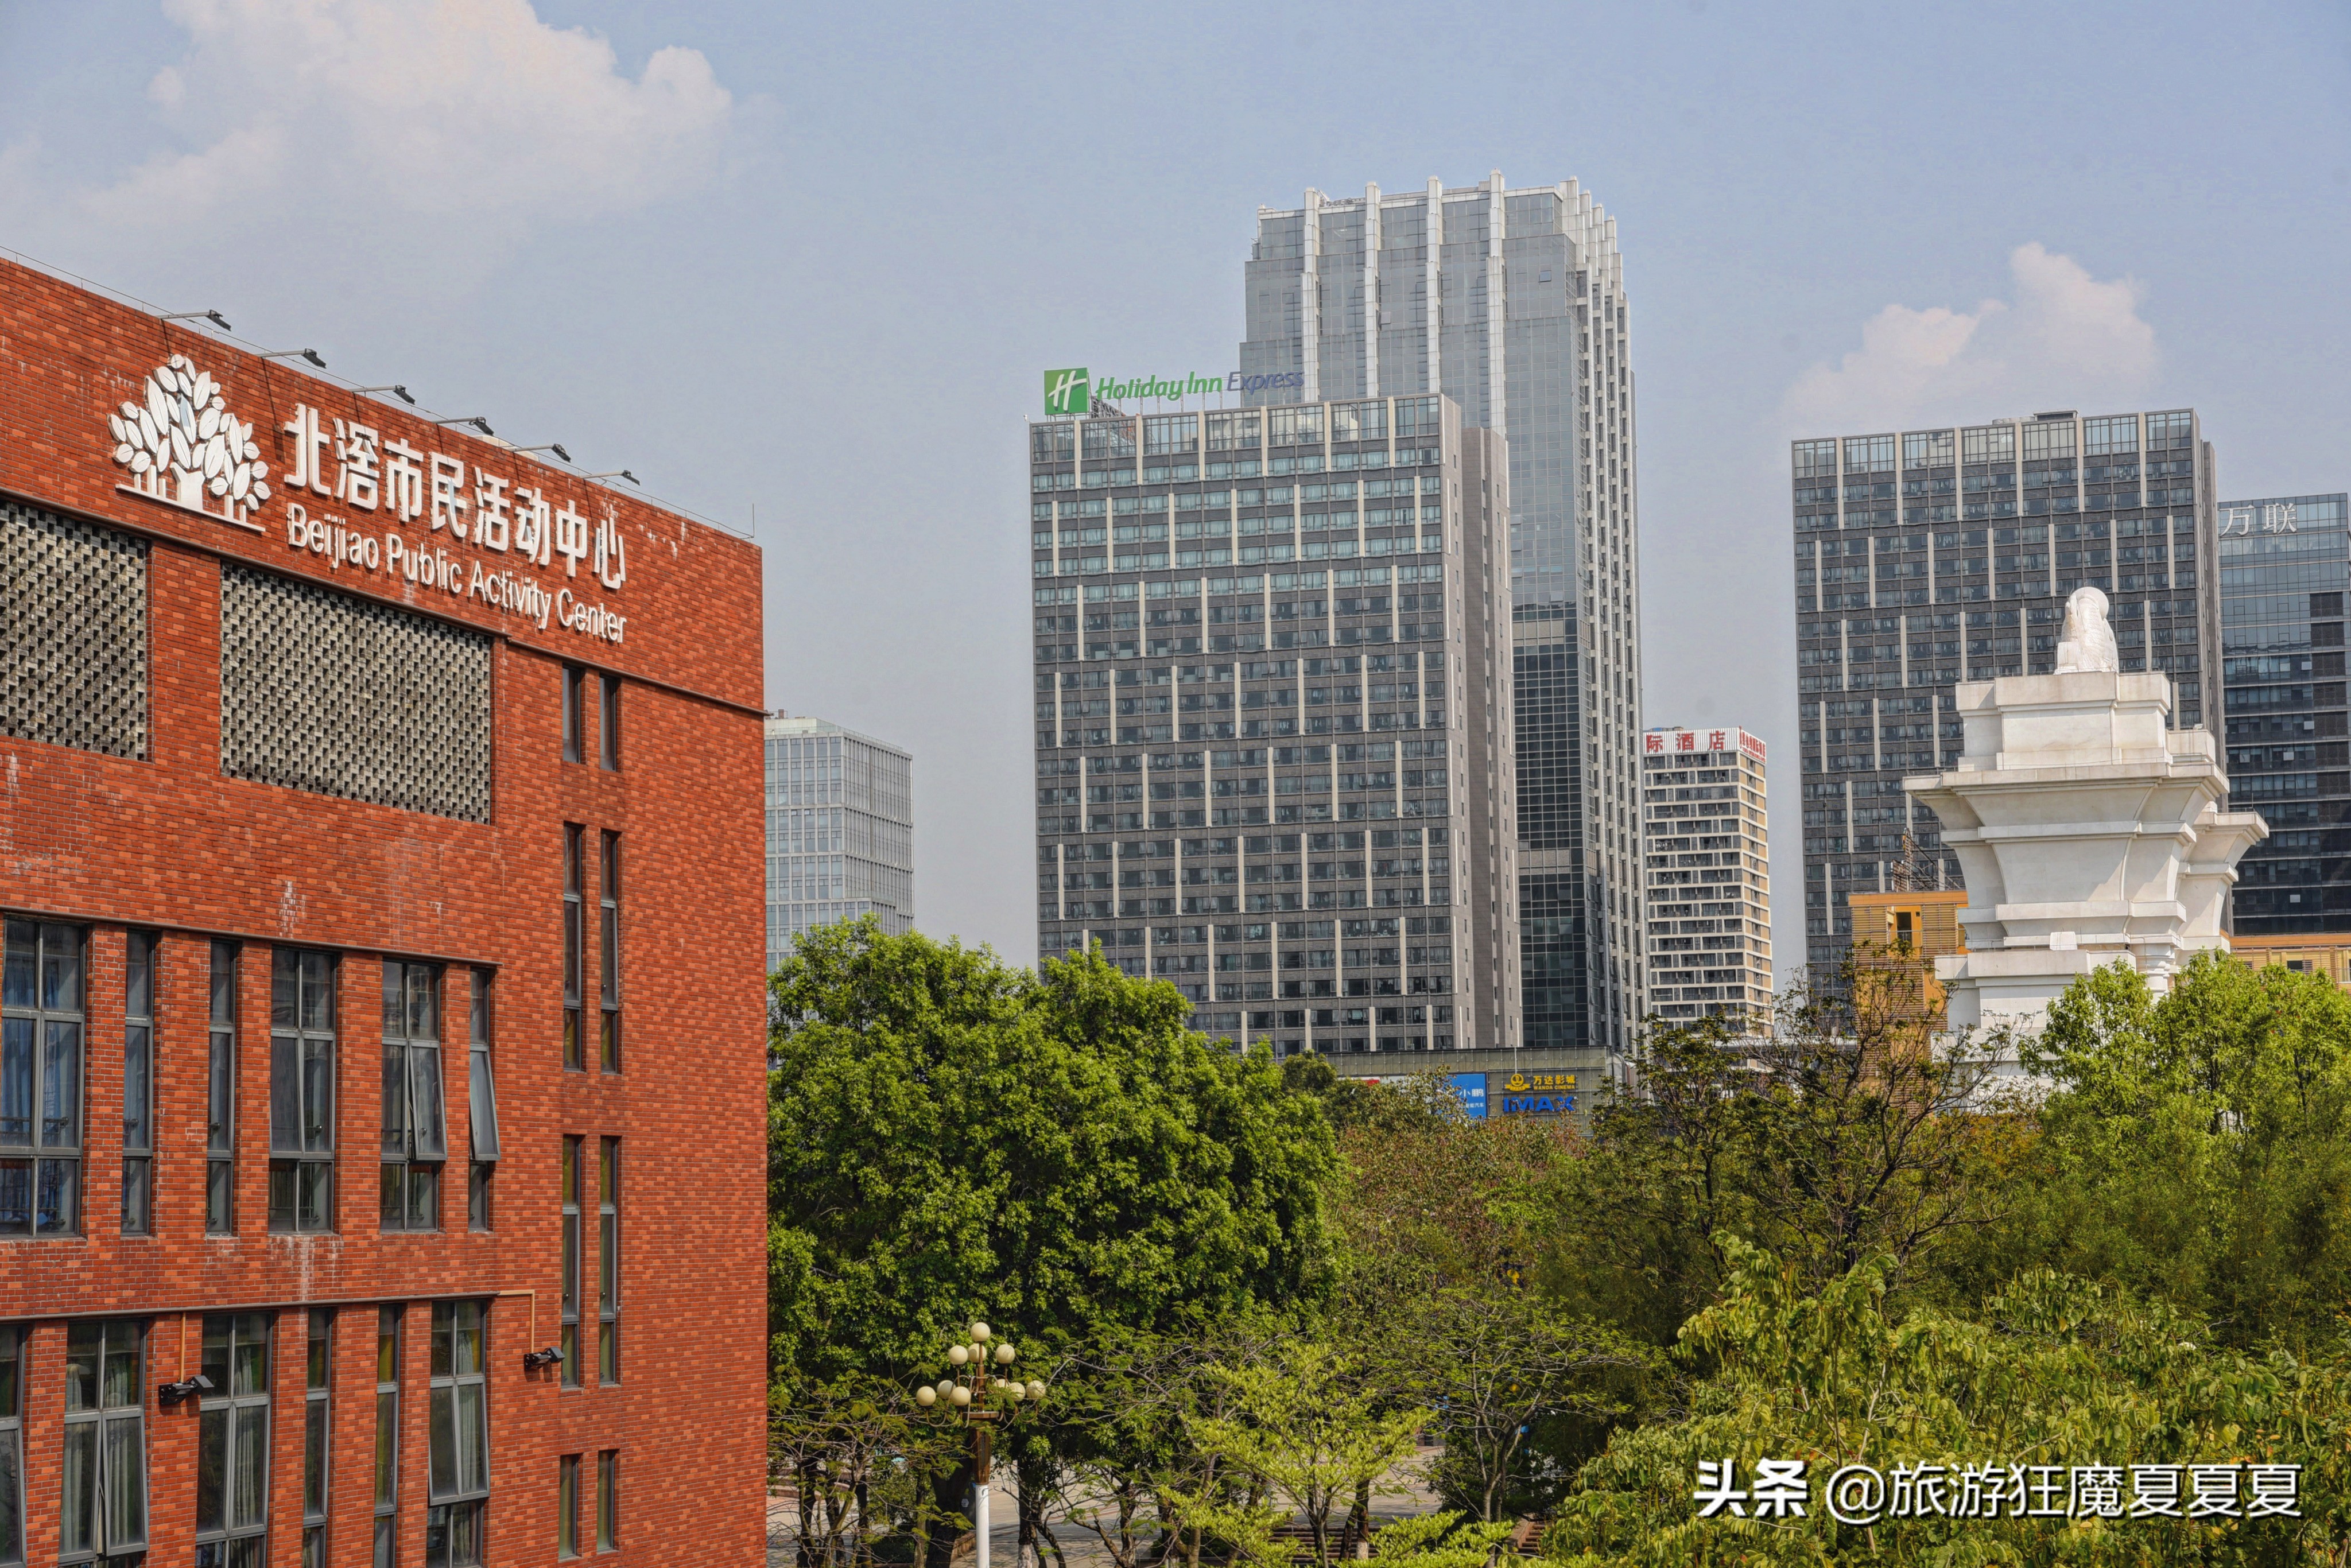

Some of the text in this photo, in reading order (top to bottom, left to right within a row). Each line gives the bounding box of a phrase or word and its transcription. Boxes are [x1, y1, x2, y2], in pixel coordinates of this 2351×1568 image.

[1095, 371, 1304, 401] Holiday Inn Express
[284, 403, 626, 589] 北滘市民活动中心
[2218, 503, 2297, 537] 万联
[287, 503, 627, 643] Beijiao Public Activity Center
[1646, 730, 1725, 754] 际酒店
[1459, 1088, 1484, 1097] 小鹏
[1533, 1074, 1576, 1085] 万达影城
[1503, 1096, 1576, 1112] IMAX
